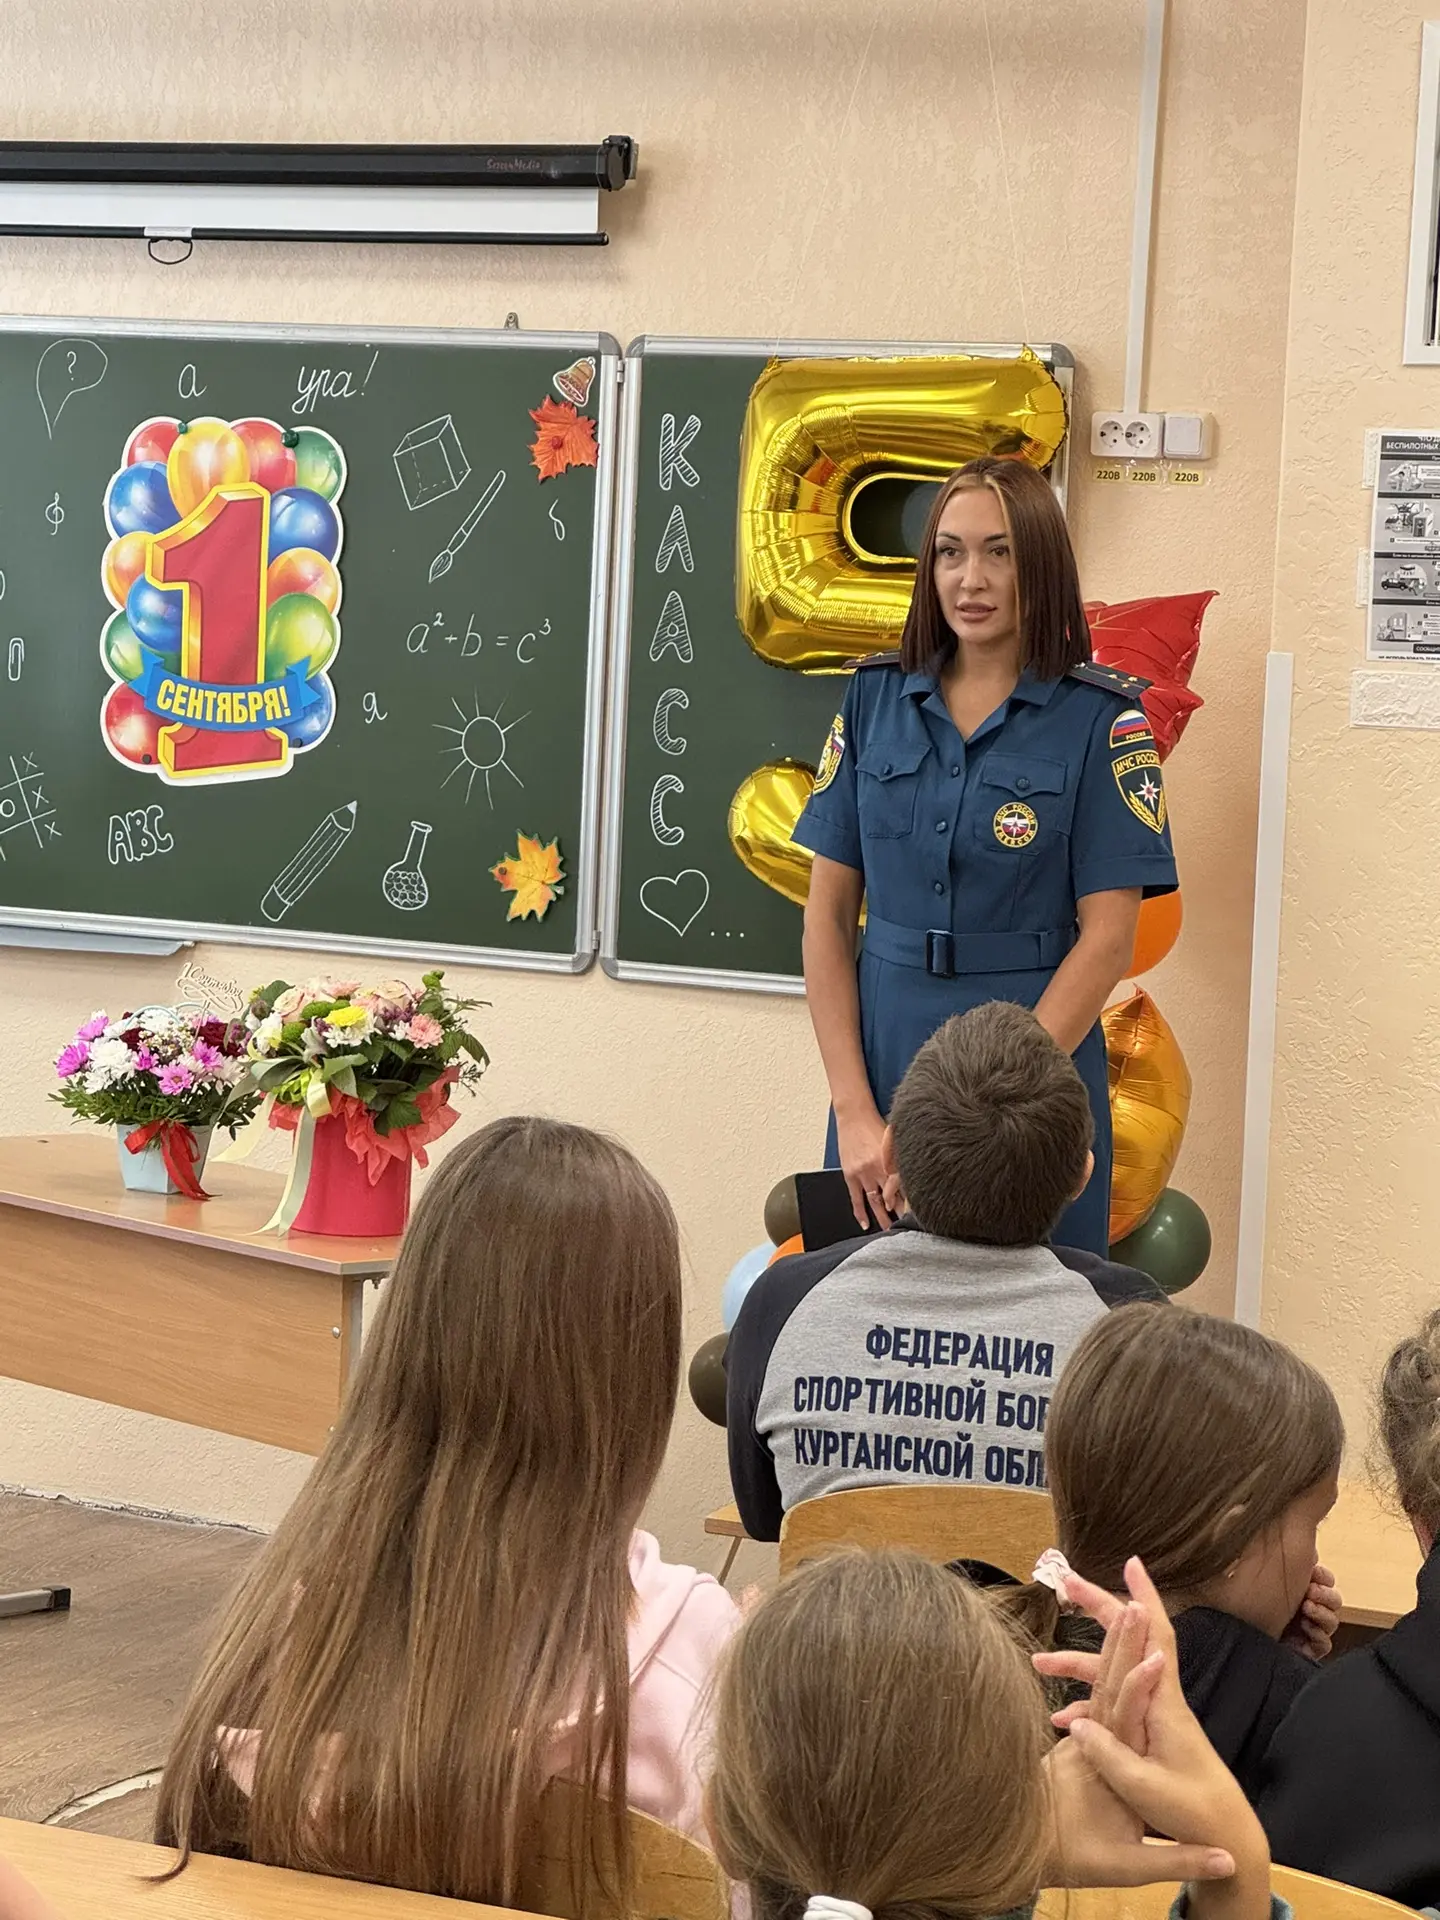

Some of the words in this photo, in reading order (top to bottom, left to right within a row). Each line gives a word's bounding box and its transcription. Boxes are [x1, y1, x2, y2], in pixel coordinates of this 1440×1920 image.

[290, 350, 379, 414] ура!
[1096, 470, 1121, 480] 220В
[1132, 471, 1156, 482] 220В
[1174, 472, 1199, 482] 220В
[145, 482, 289, 779] 1
[156, 677, 292, 725] СЕНТЯБРЯ!
[1125, 731, 1146, 741] РОССИЯ
[1115, 756, 1136, 774] МЧС
[107, 804, 175, 865] ABC
[865, 1323, 1055, 1379] ФЕДЕРАЦИЯ
[793, 1375, 986, 1425] СПОРТИВНОЙ
[793, 1427, 974, 1480] КУРГАНСКОЙ
